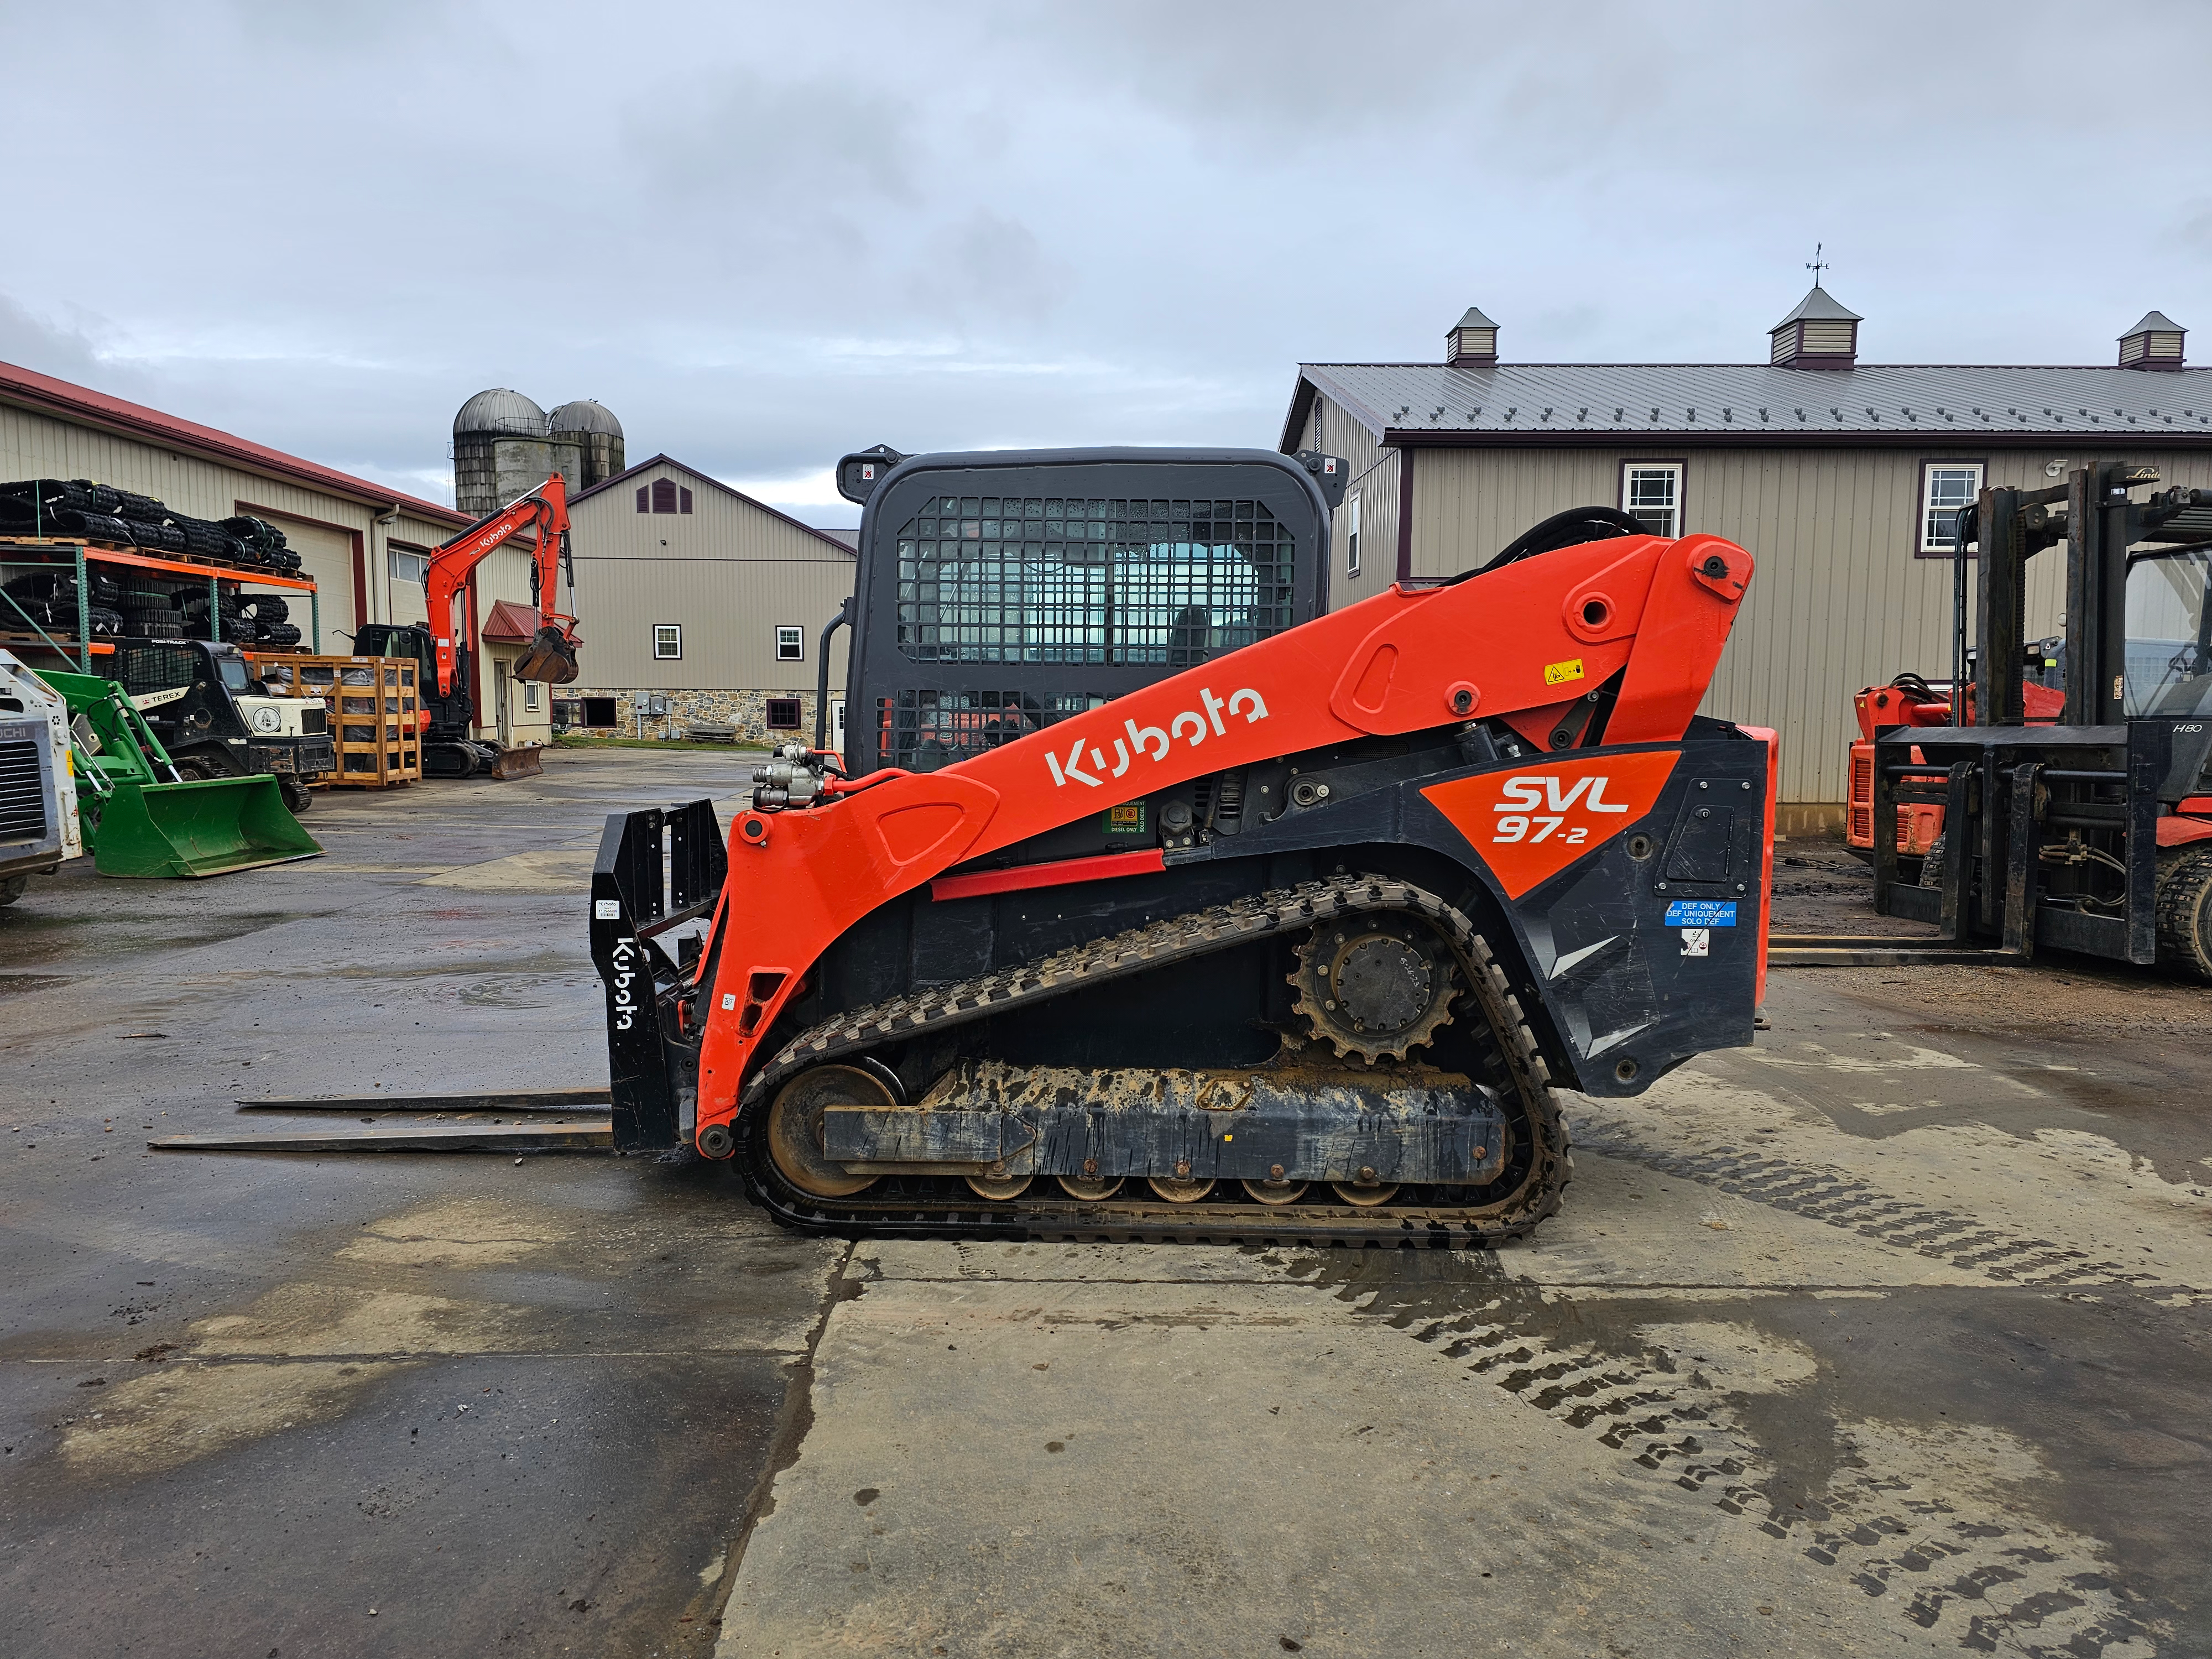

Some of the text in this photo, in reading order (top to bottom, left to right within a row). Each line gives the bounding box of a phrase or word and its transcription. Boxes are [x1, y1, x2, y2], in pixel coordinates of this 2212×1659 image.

[479, 524, 512, 547] Kubota
[151, 691, 181, 702] TEREX
[1045, 687, 1269, 787] Kubota
[2173, 724, 2203, 733] H80
[1493, 776, 1629, 812] SVL
[1493, 816, 1588, 843] 97-2
[613, 937, 638, 1030] Kubota
